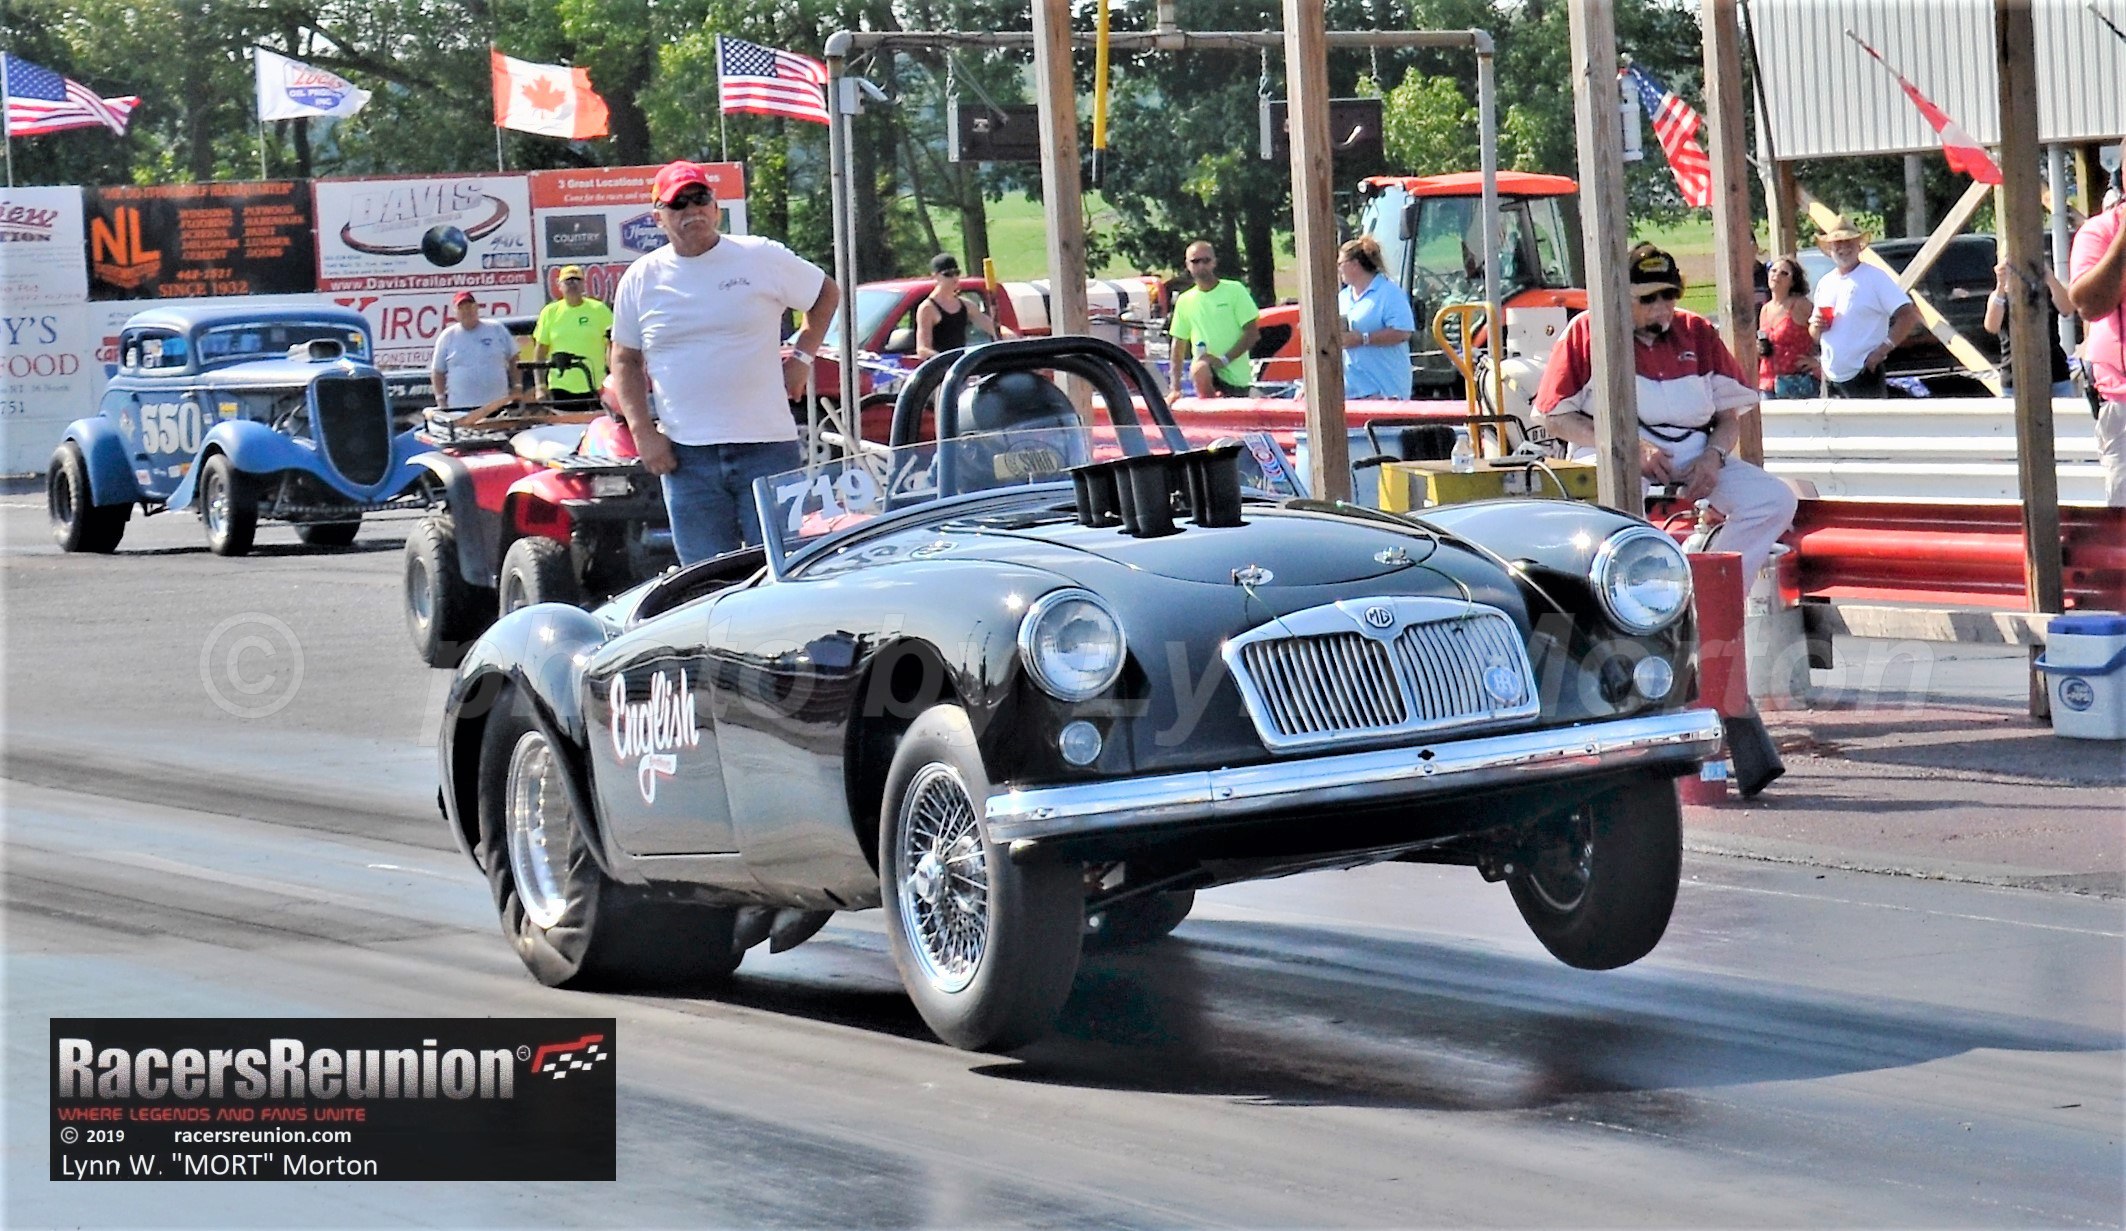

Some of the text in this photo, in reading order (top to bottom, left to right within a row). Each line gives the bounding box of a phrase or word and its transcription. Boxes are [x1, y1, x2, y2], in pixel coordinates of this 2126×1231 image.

[558, 180, 565, 189] 3
[568, 179, 594, 188] Great
[596, 177, 644, 188] Locations
[348, 182, 481, 228] DAVIS
[91, 206, 161, 265] NL
[159, 280, 249, 297] SINCE 1932
[330, 274, 527, 291] www.DavisTrailerWorld.com
[0, 315, 57, 345] Y'S
[140, 402, 200, 455] 550
[776, 468, 877, 532] 719
[1369, 608, 1391, 626] MG
[610, 667, 700, 803] English
